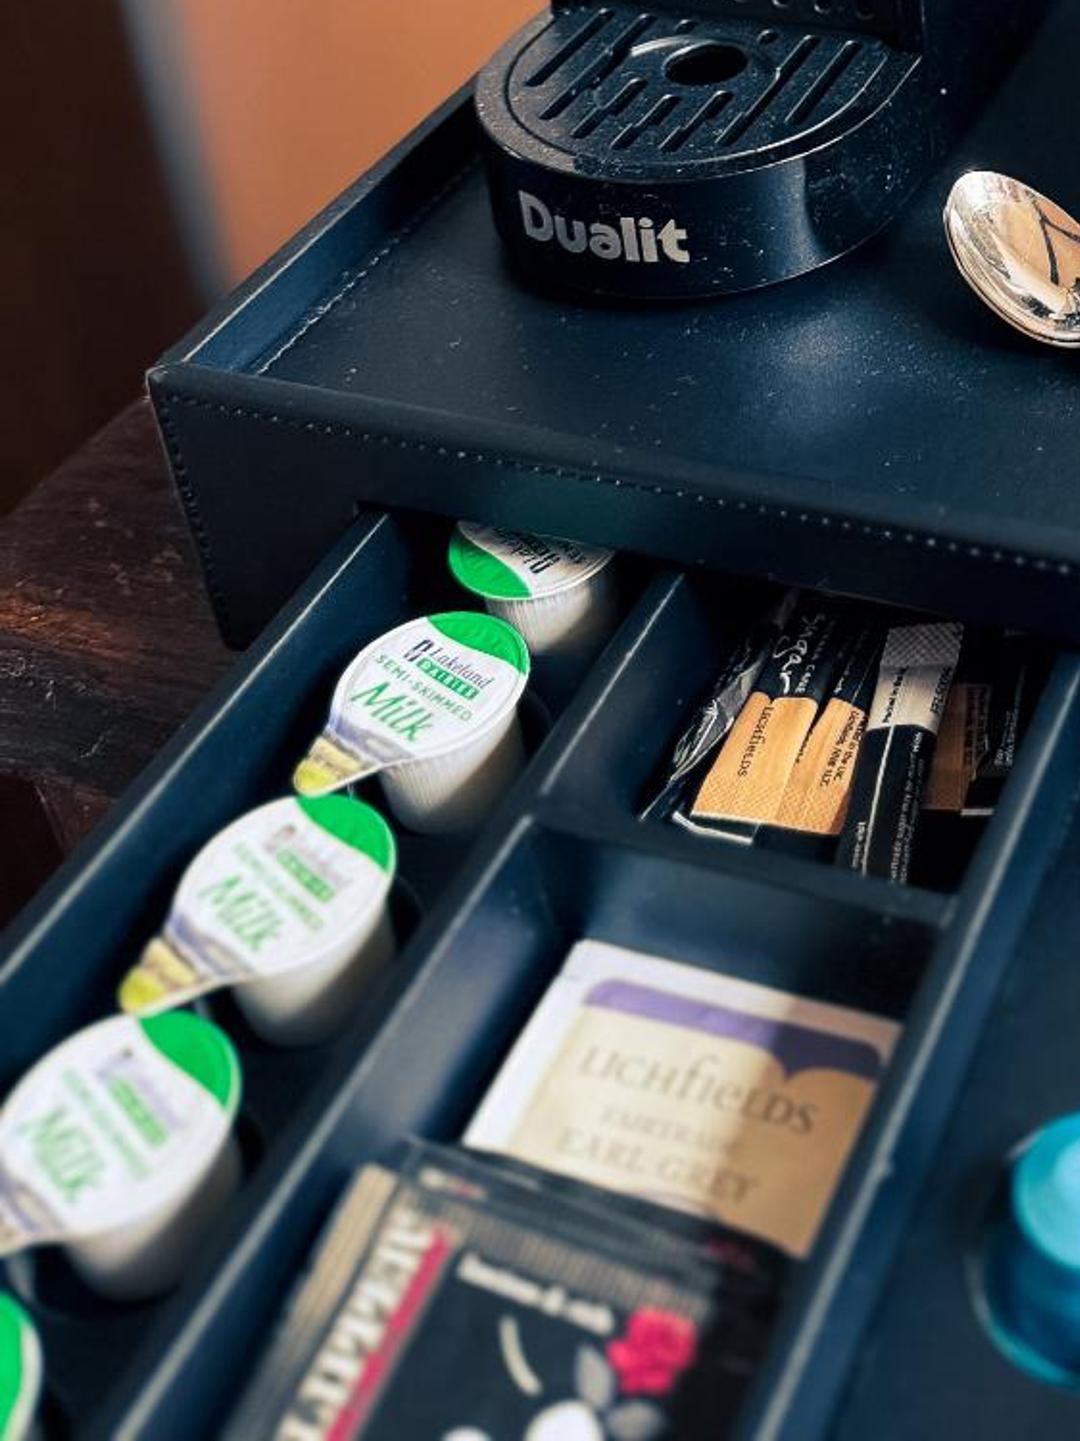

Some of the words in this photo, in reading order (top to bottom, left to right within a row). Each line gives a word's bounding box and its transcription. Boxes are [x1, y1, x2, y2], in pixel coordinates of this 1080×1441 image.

[518, 190, 690, 263] Dualit
[350, 681, 434, 743] Milk
[376, 654, 473, 722] SEMI-SKIMMED
[558, 1126, 648, 1172] EARL
[658, 1154, 759, 1204] GREY
